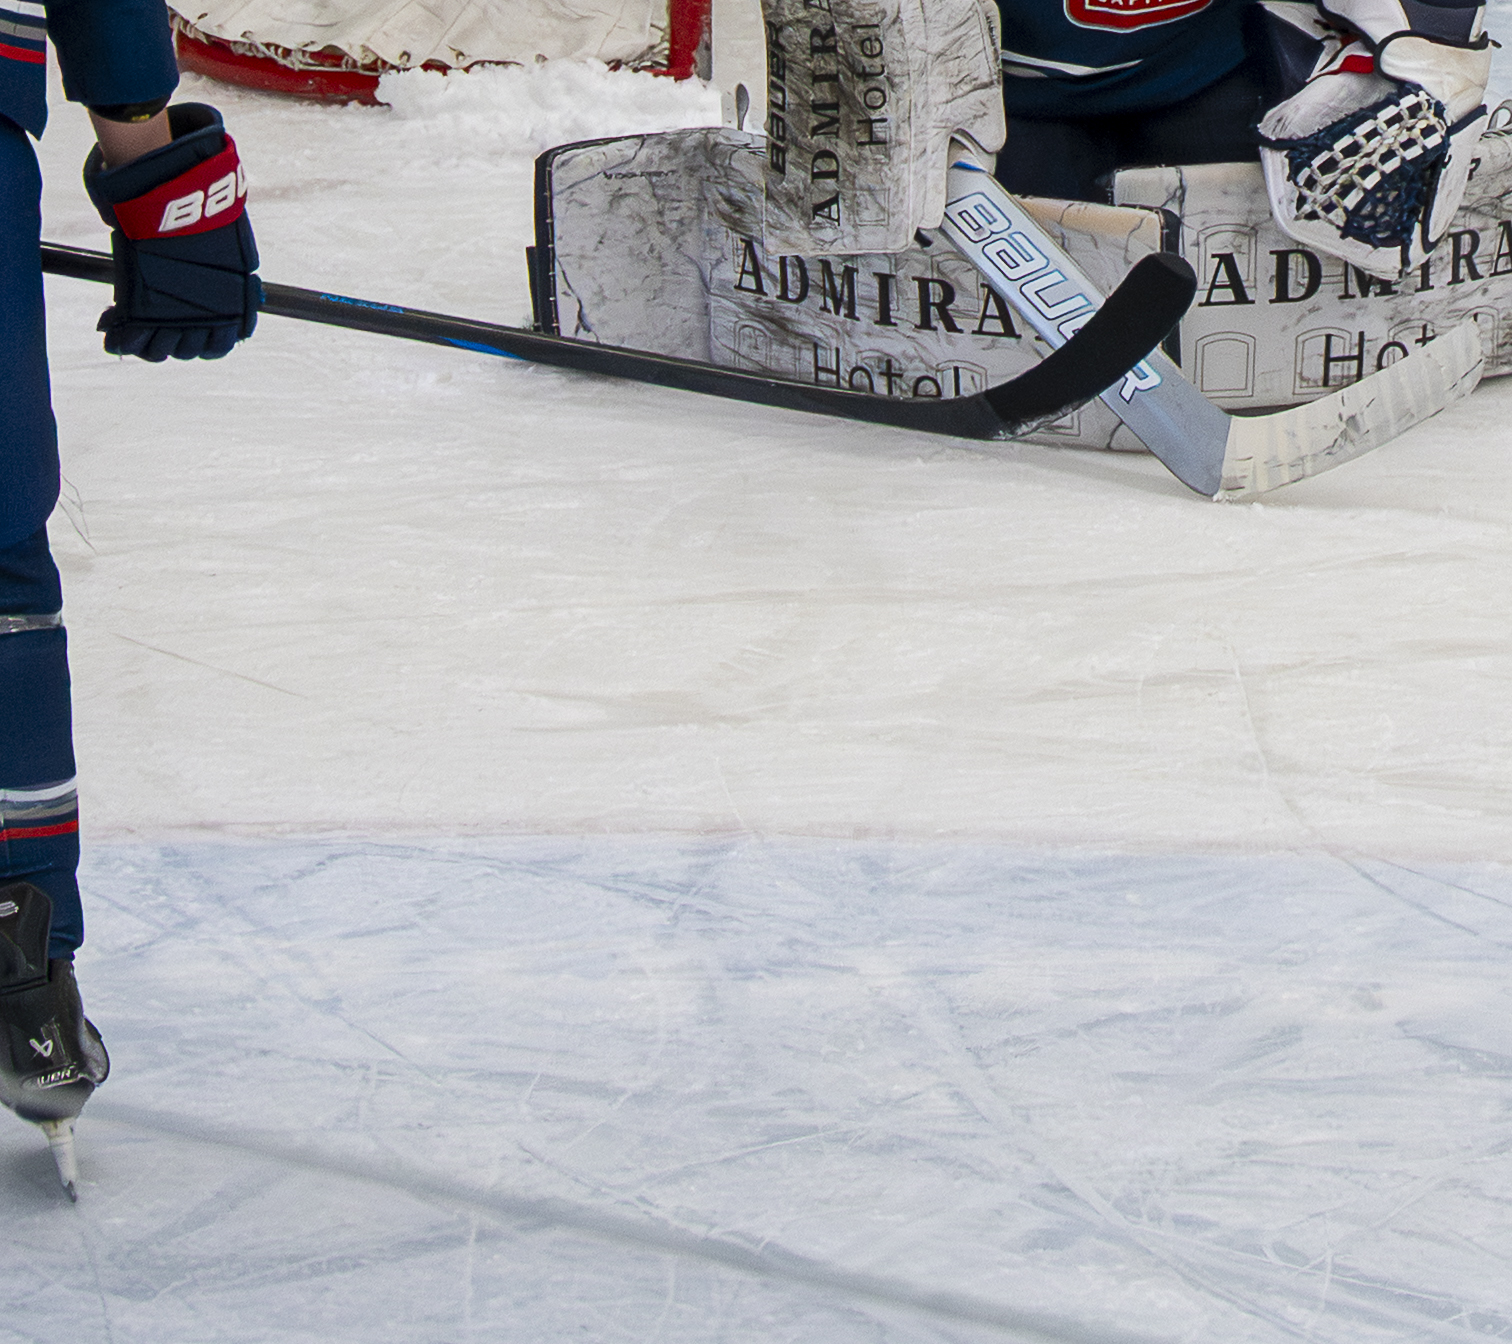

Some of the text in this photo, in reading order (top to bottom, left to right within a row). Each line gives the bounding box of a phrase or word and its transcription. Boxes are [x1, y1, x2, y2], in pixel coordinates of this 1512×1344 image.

[768, 19, 788, 176] BAUER
[855, 21, 889, 147] Hotel
[733, 238, 1028, 341] ADMIRA
[947, 192, 1162, 405] BAUR
[1323, 321, 1437, 388] Hot
